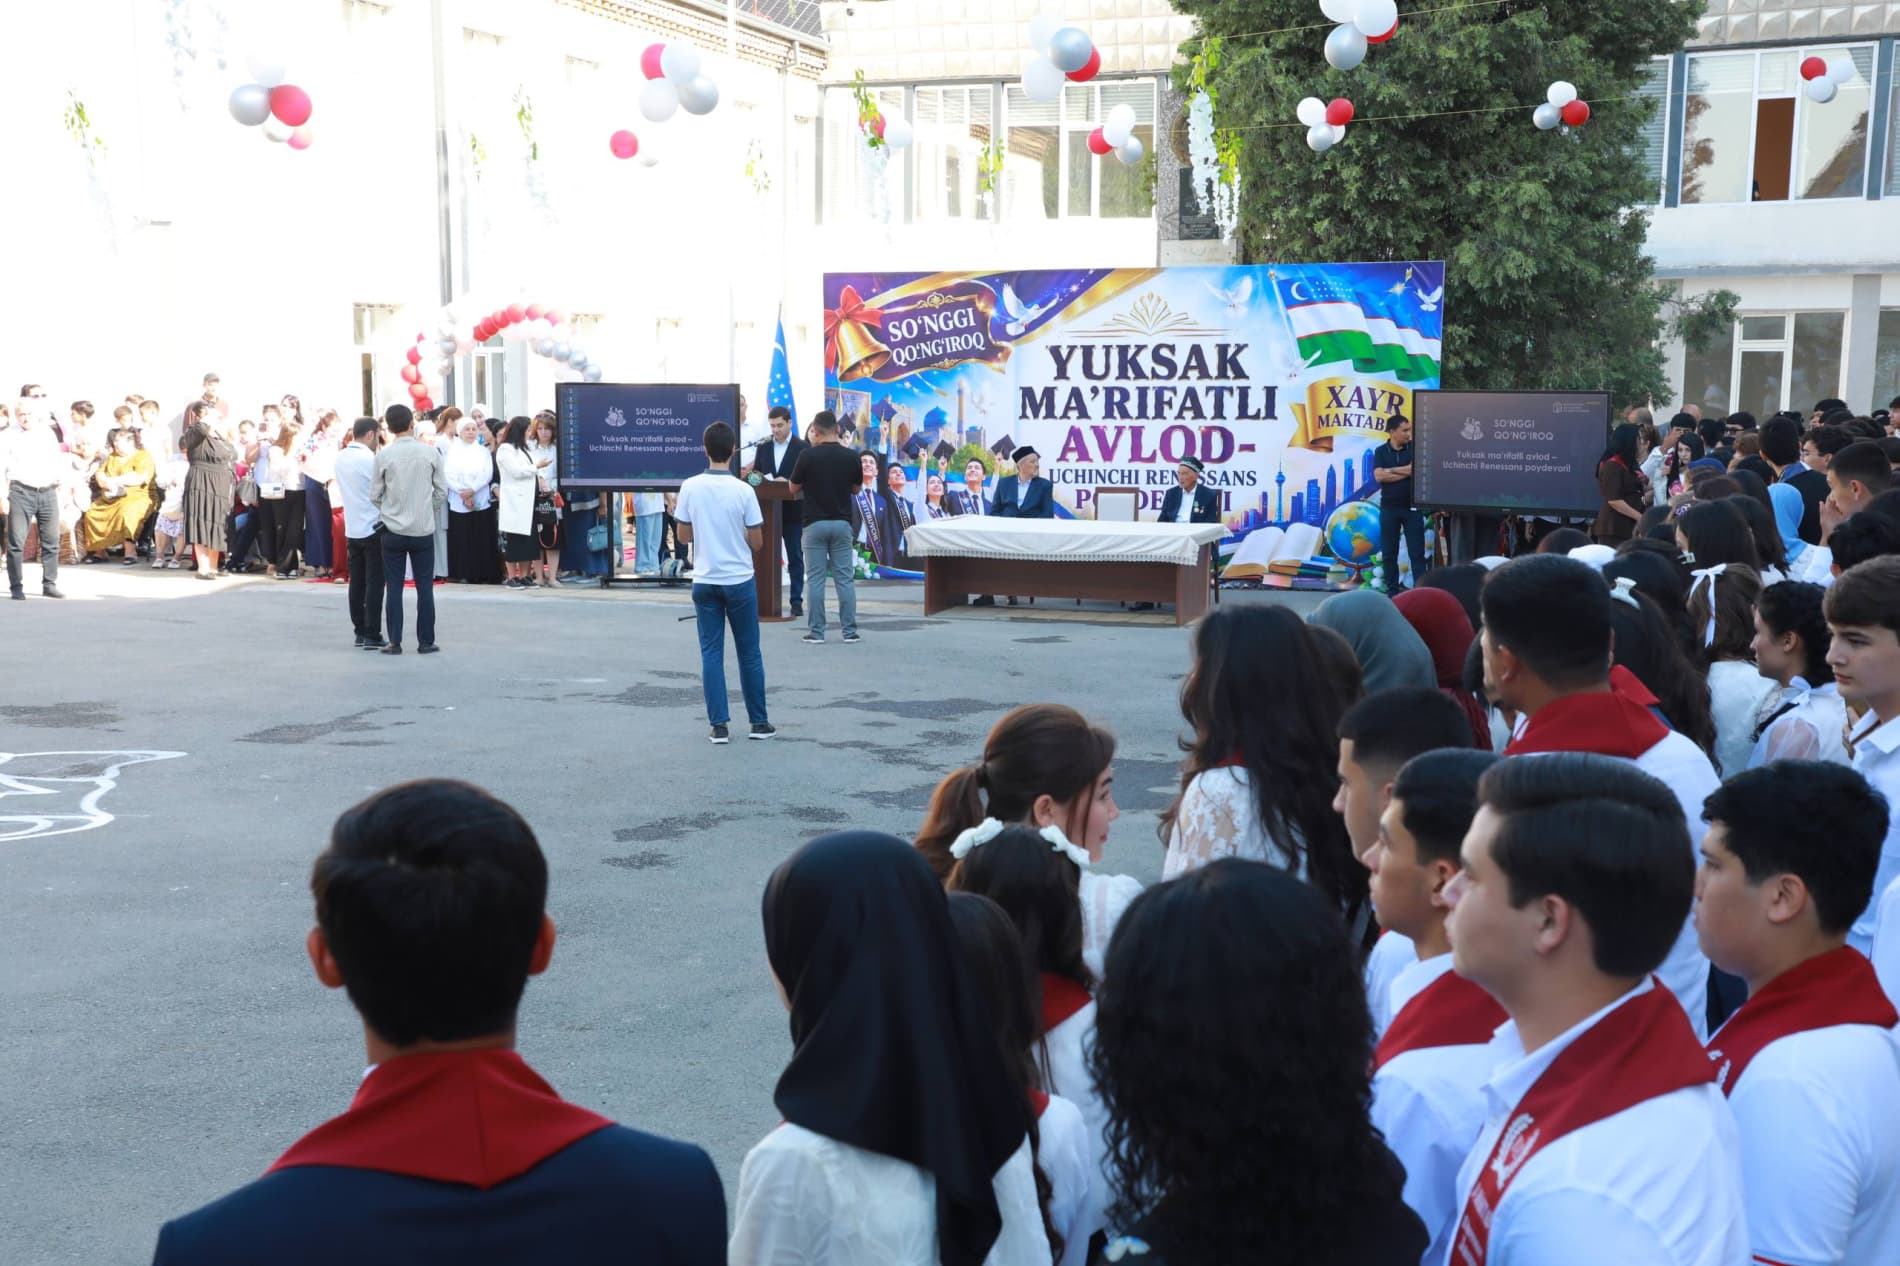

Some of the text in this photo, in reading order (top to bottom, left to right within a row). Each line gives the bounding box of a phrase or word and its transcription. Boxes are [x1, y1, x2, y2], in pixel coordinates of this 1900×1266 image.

[888, 308, 976, 342] SO‘NGGI
[892, 332, 985, 367] QO‘NG‘IROQ
[1047, 343, 1249, 380] YUKSAK
[1019, 386, 1278, 420] MA’RIFATLI
[1325, 385, 1405, 416] XAYR
[1057, 424, 1256, 463] AVLOD-
[1050, 468, 1257, 486] UCHINCHI RENSSANS
